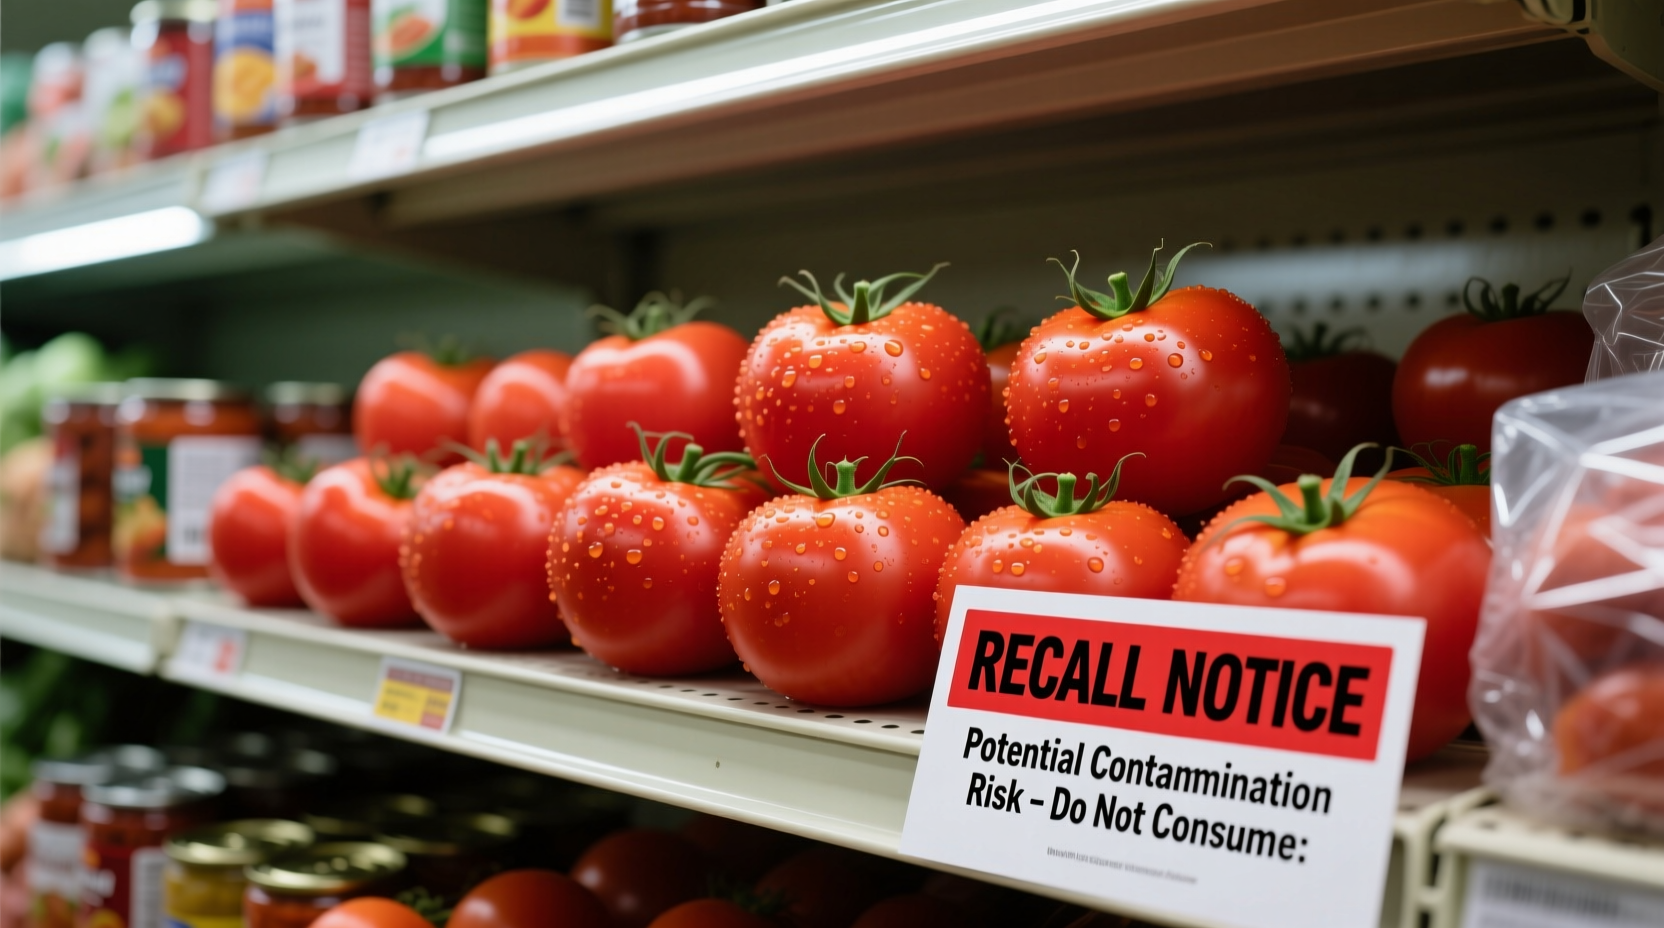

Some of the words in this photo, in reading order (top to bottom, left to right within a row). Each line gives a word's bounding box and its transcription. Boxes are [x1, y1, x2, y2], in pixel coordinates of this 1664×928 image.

[967, 629, 1147, 711] RECALL
[1162, 648, 1371, 737] NOTICE
[962, 726, 1086, 776] Potential
[965, 772, 1025, 814] Risk
[1049, 786, 1087, 825] Do
[1092, 793, 1147, 836] Not
[1152, 802, 1309, 864] Consume:
